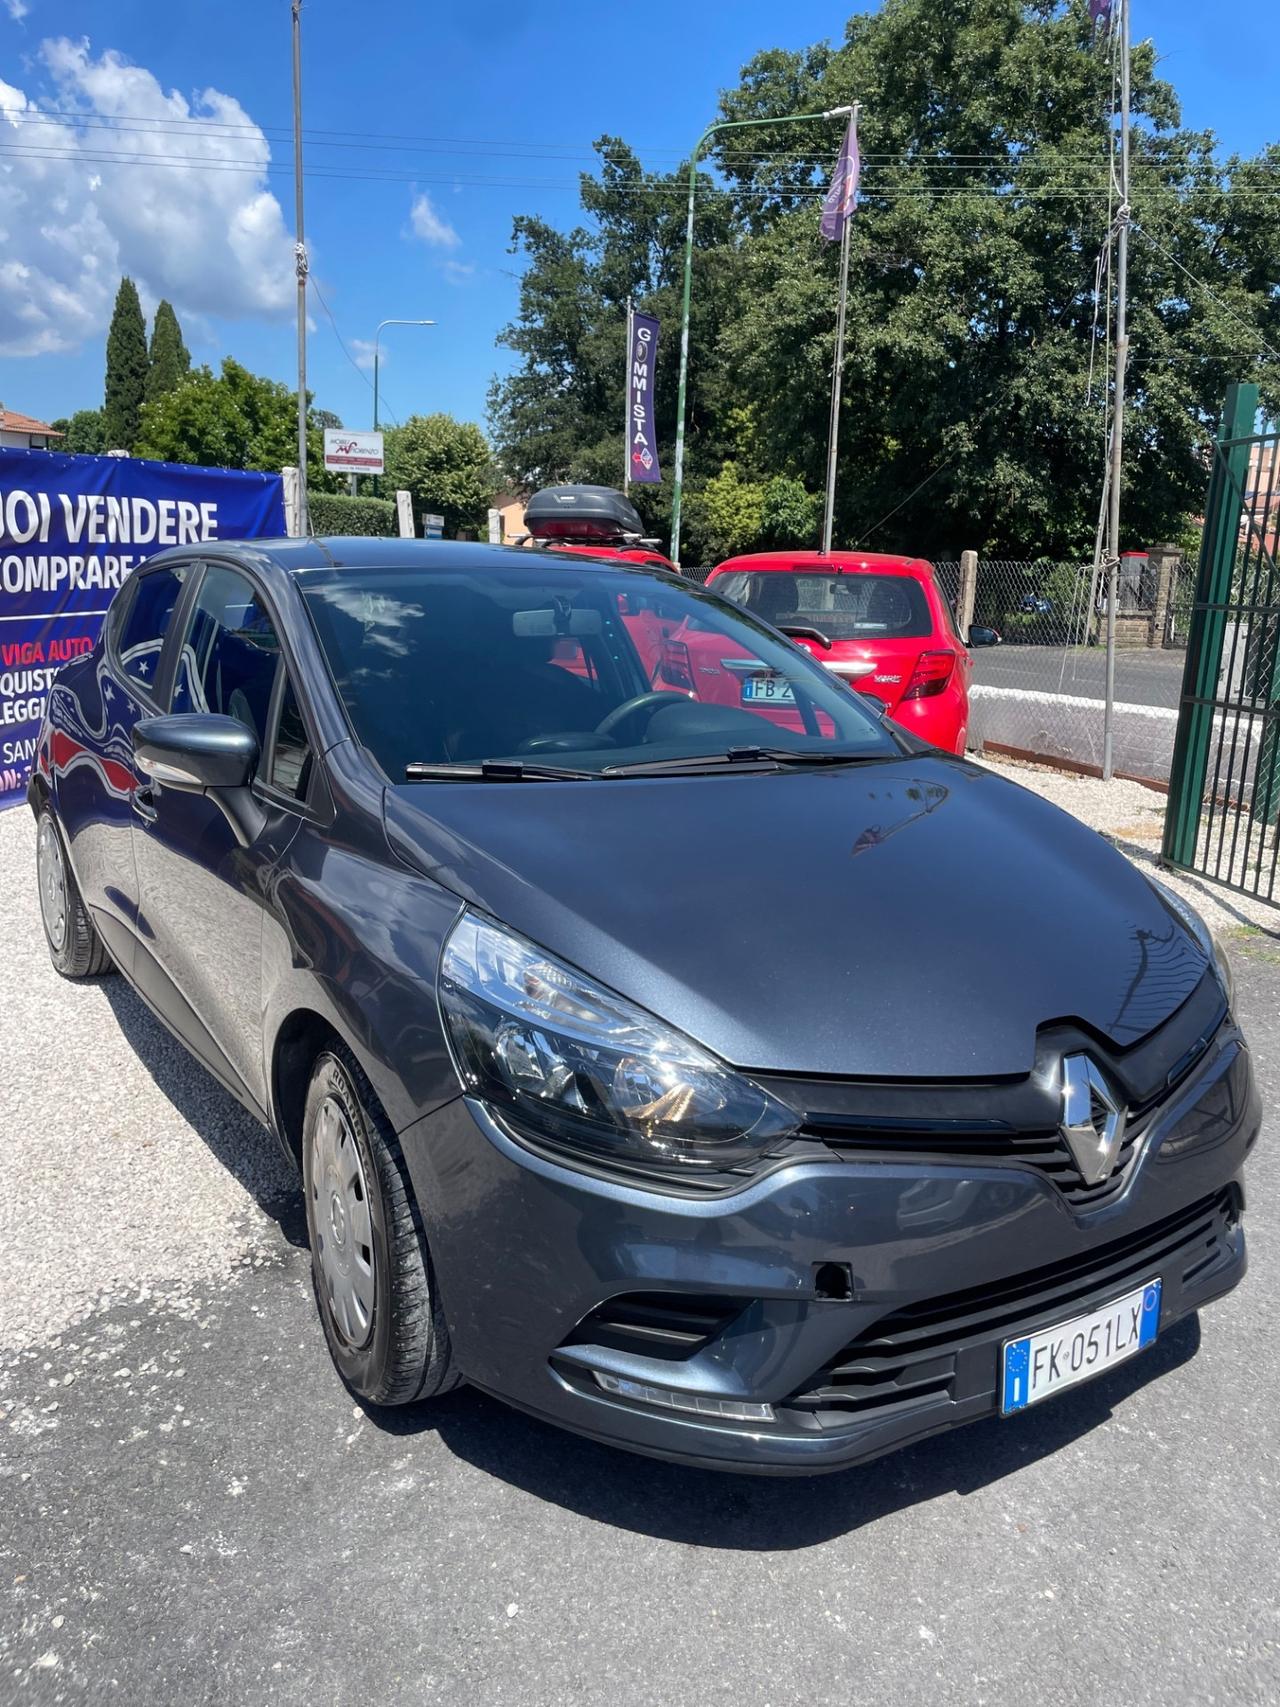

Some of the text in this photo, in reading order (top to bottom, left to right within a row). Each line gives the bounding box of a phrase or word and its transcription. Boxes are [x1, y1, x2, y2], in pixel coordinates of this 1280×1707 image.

[0, 490, 218, 545] OI VENDERE
[0, 555, 134, 593] OMPRARE
[2, 642, 45, 666] VIGA
[0, 667, 60, 698] QUIST
[754, 680, 775, 697] FB
[1032, 1339, 1064, 1390] FK
[1071, 1303, 1142, 1372] 051LX
